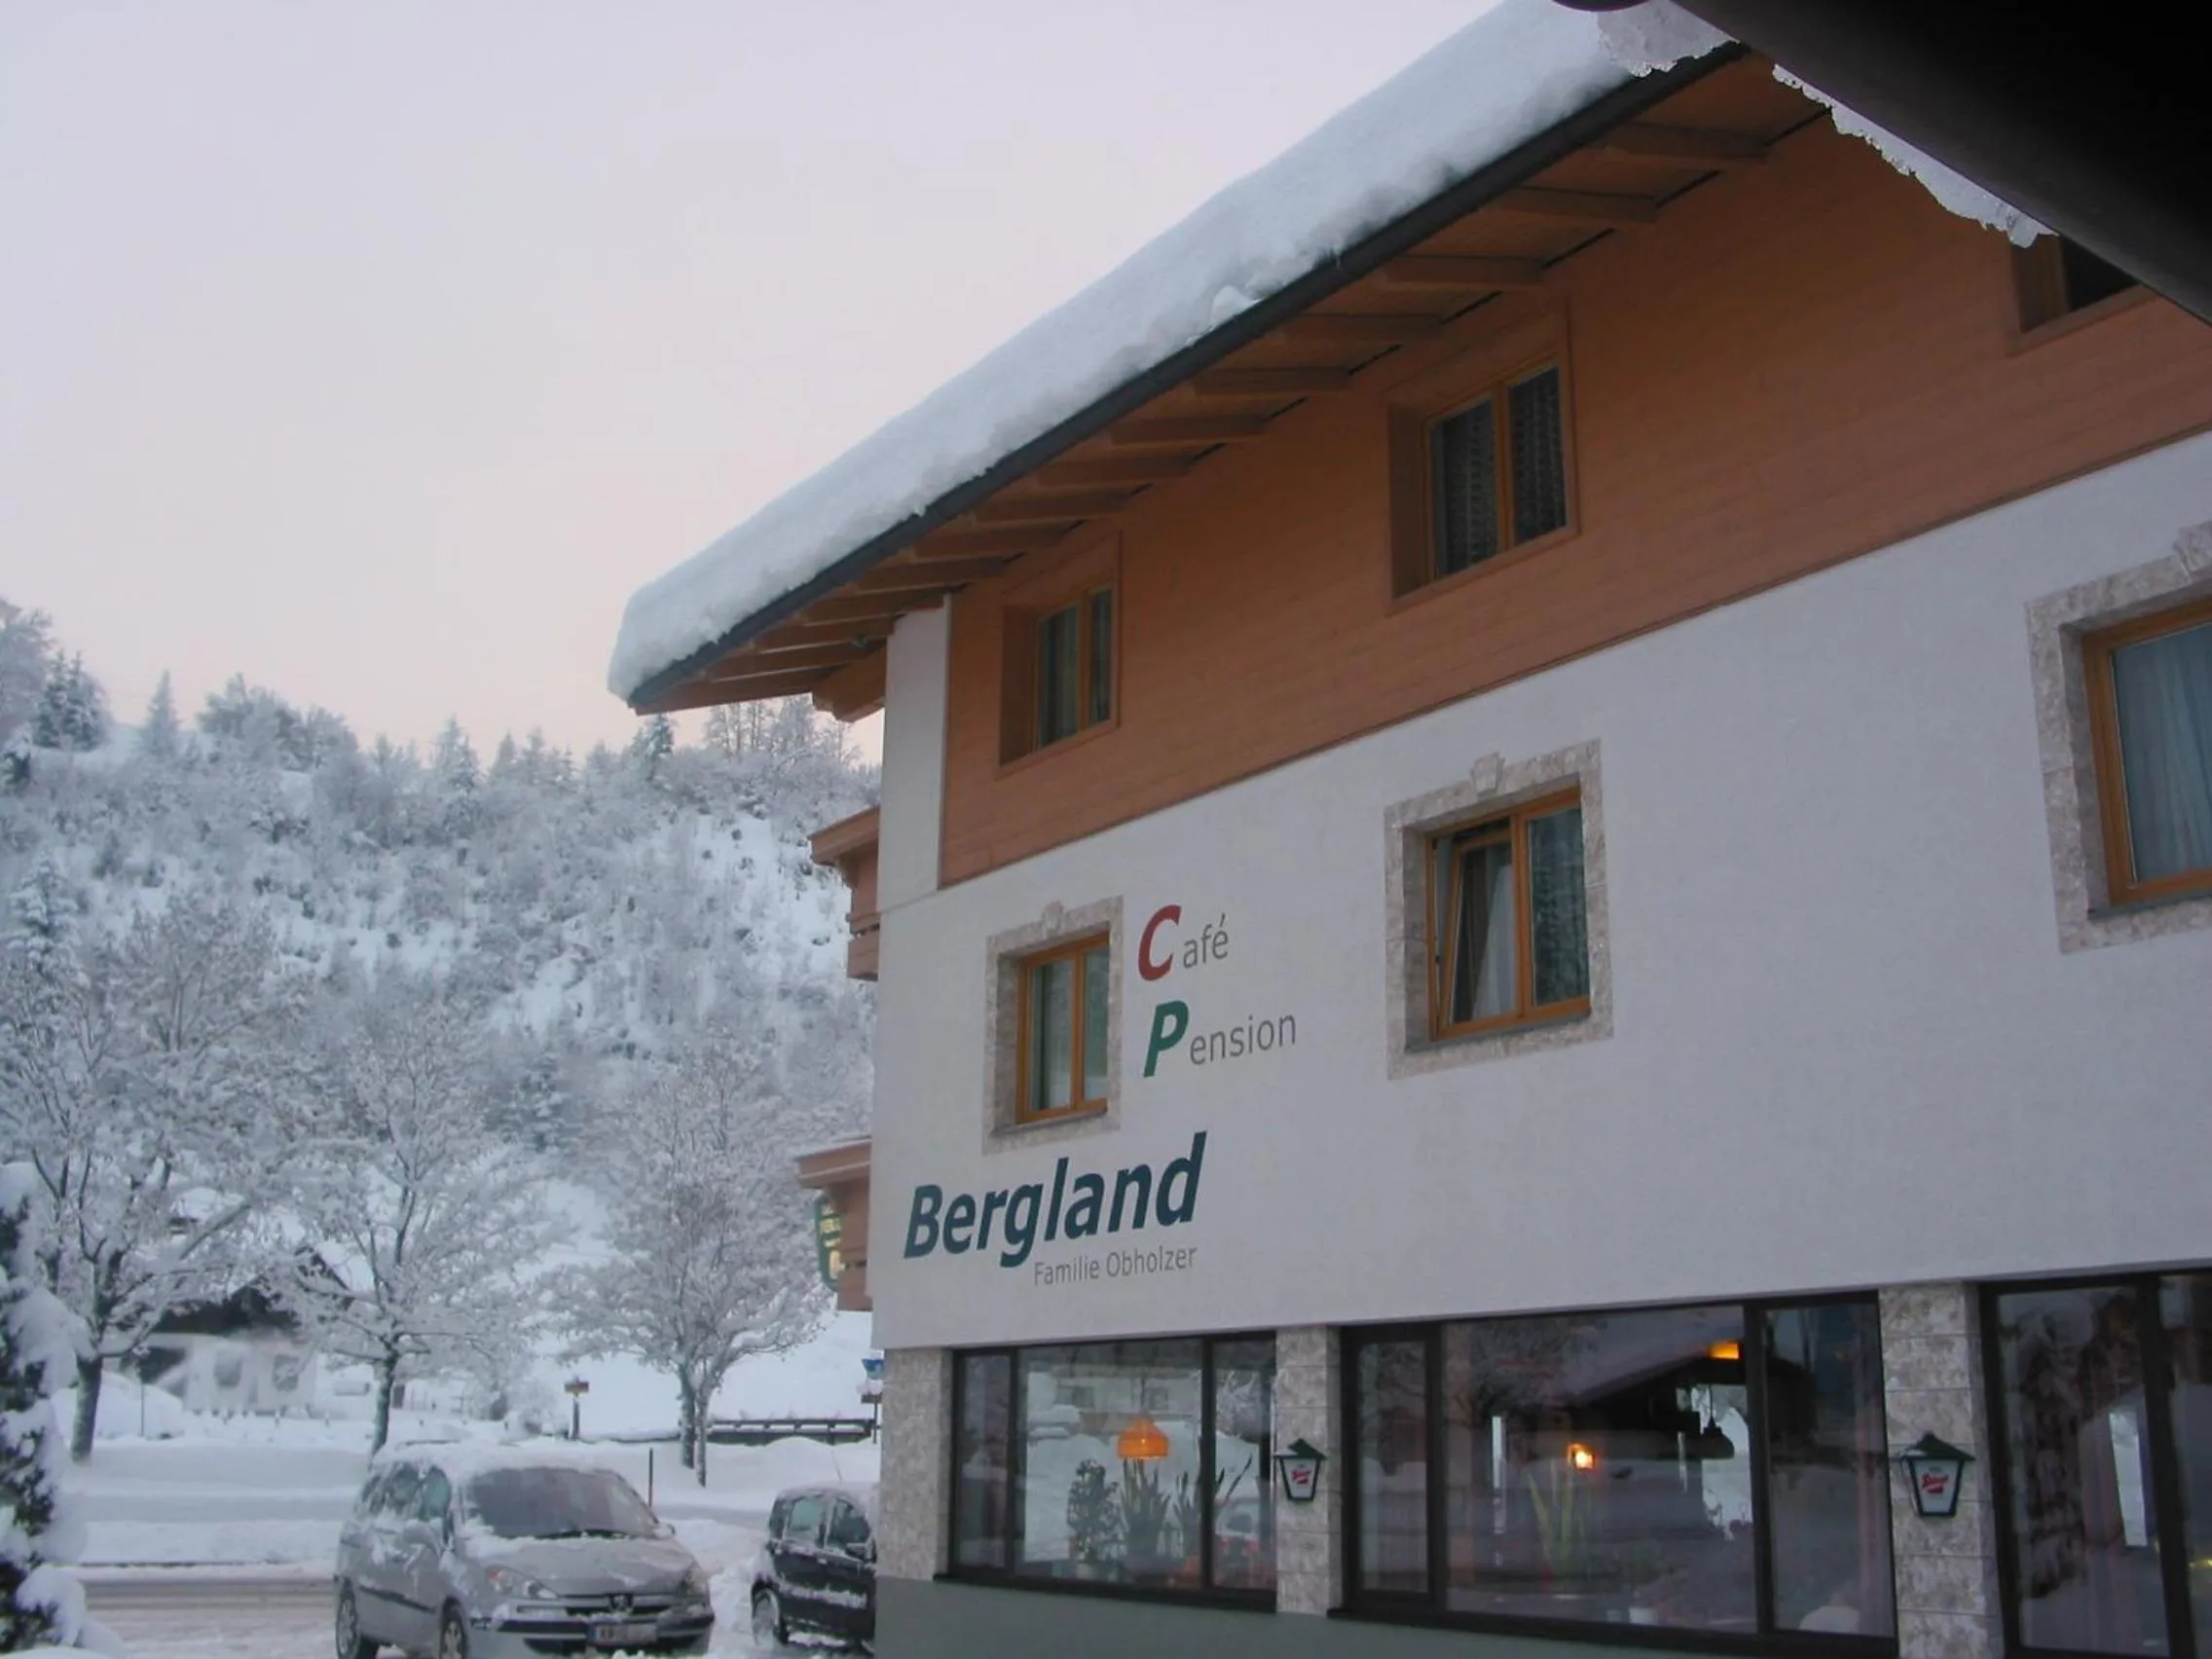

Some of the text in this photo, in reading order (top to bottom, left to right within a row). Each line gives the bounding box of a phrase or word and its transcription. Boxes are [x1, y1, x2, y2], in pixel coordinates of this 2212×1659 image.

[1138, 904, 1230, 981] Café
[1143, 1000, 1296, 1078] Pension
[903, 1131, 1207, 1268] Bergland
[1034, 1245, 1197, 1286] Familie Obholzer
